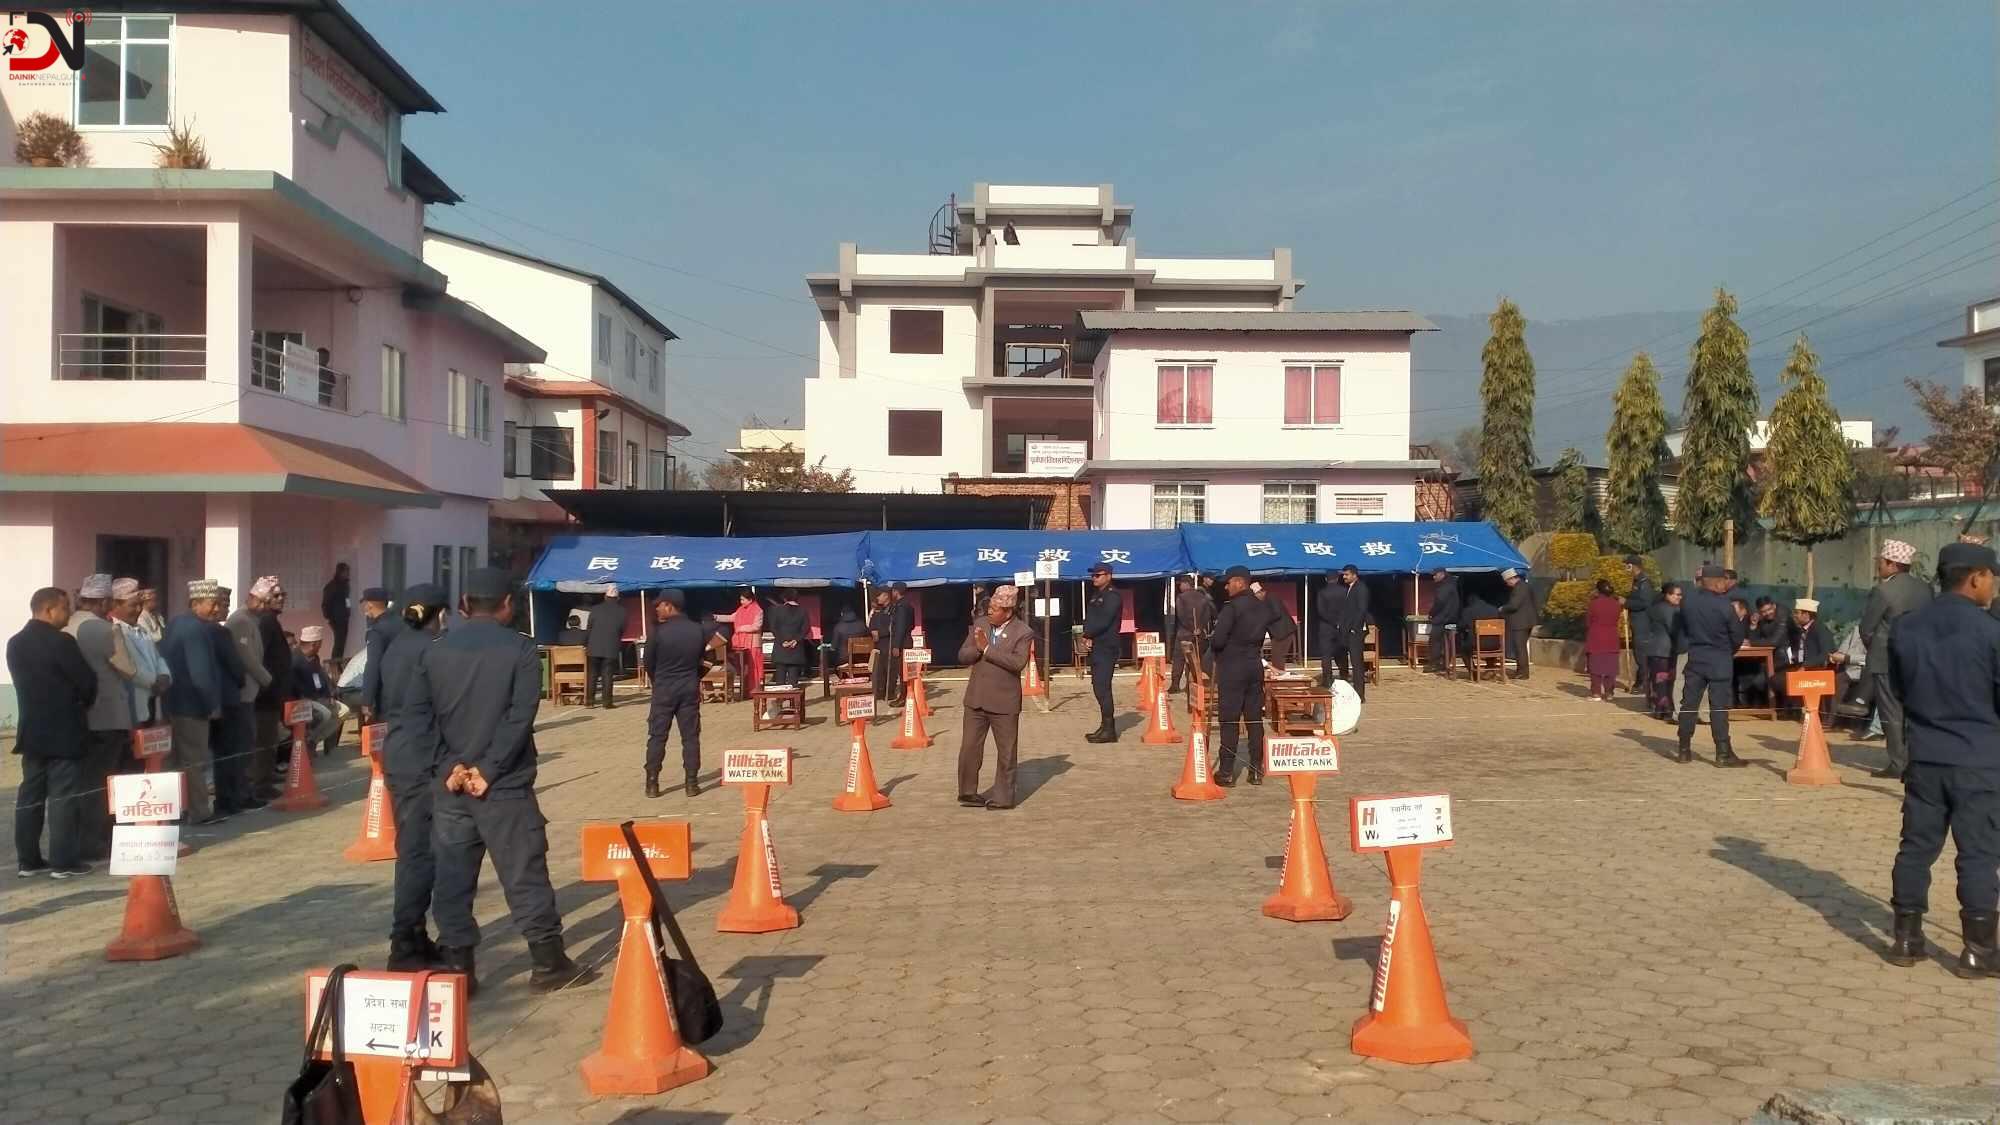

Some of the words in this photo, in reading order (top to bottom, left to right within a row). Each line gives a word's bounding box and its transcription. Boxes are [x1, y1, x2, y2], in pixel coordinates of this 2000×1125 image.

[1245, 542, 1454, 556] 民政救灾
[587, 556, 809, 571] 民政救灾
[917, 548, 1132, 567] 民政救灾
[1271, 743, 1331, 757] Hilltake
[727, 753, 783, 768] Hilltake
[1273, 759, 1305, 768] WATER
[1308, 758, 1332, 767] TANK
[728, 769, 758, 777] WATER
[760, 769, 784, 777] TANK
[122, 800, 173, 817] महिला
